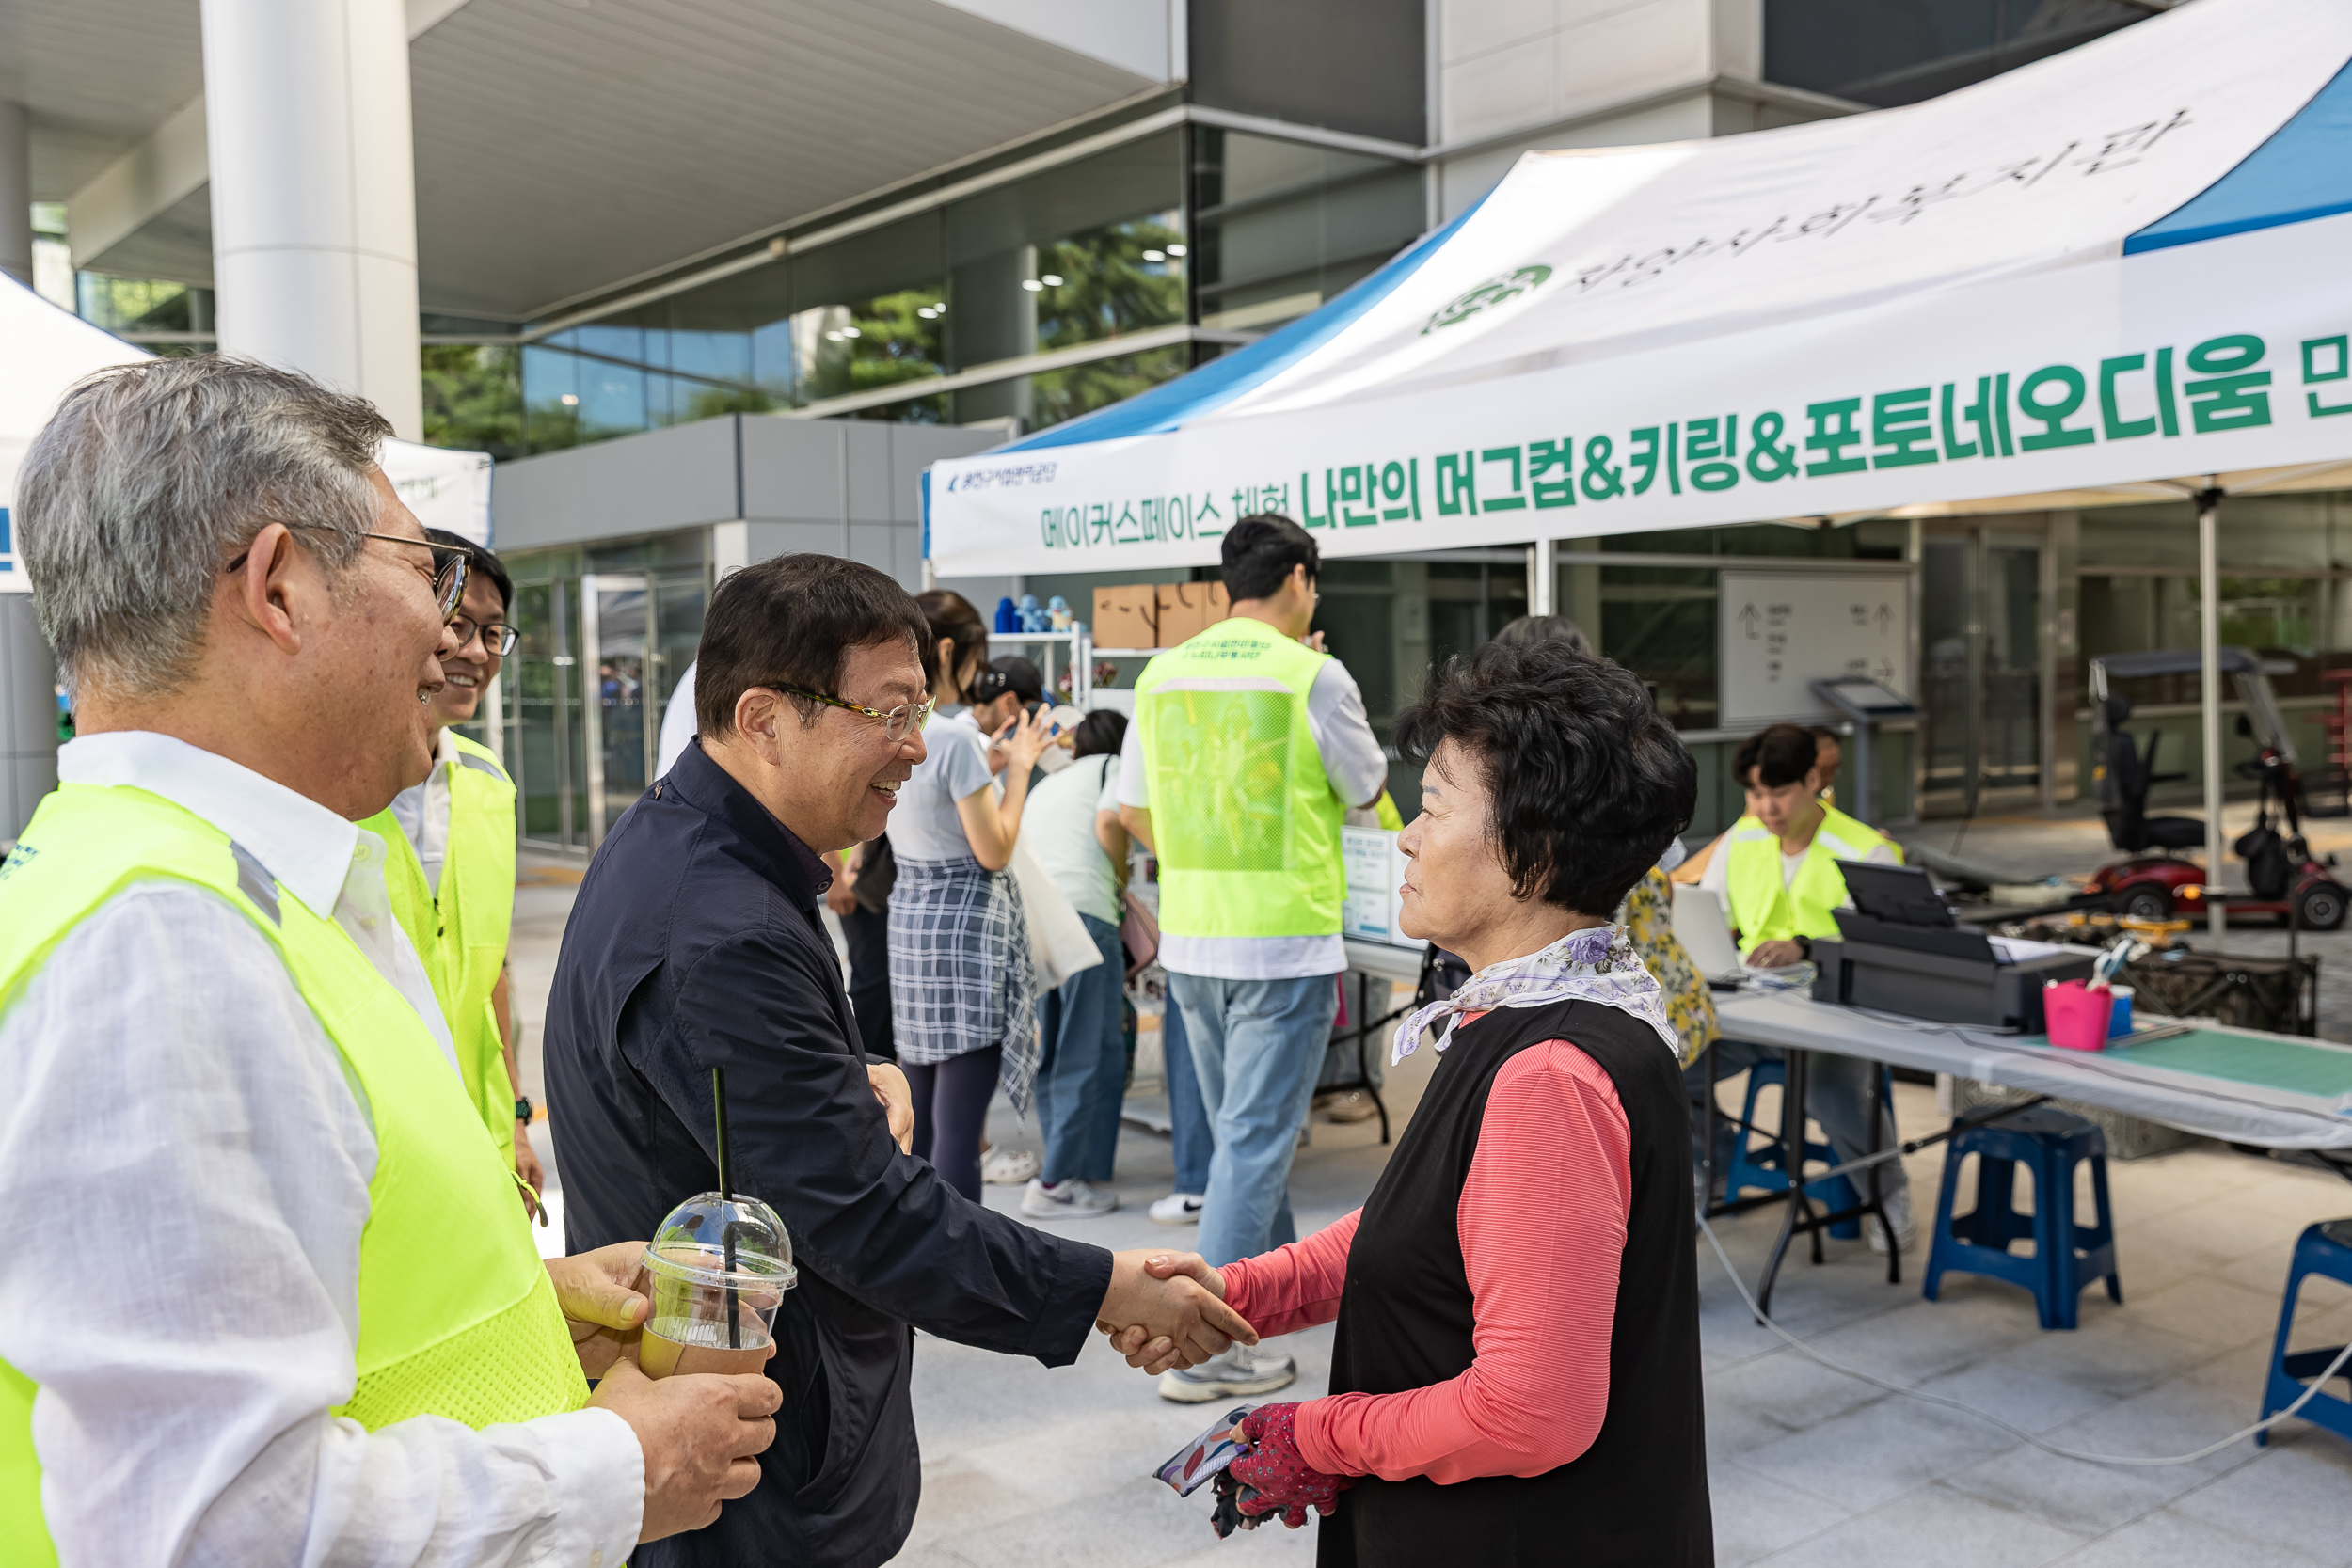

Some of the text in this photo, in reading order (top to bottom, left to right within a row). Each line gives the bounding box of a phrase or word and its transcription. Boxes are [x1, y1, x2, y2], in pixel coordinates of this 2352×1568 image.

[1041, 492, 1223, 548] 메이커스페이스
[1301, 457, 1422, 530] 나만의
[1435, 334, 2272, 515] 머그컵&키링&포토네오디움
